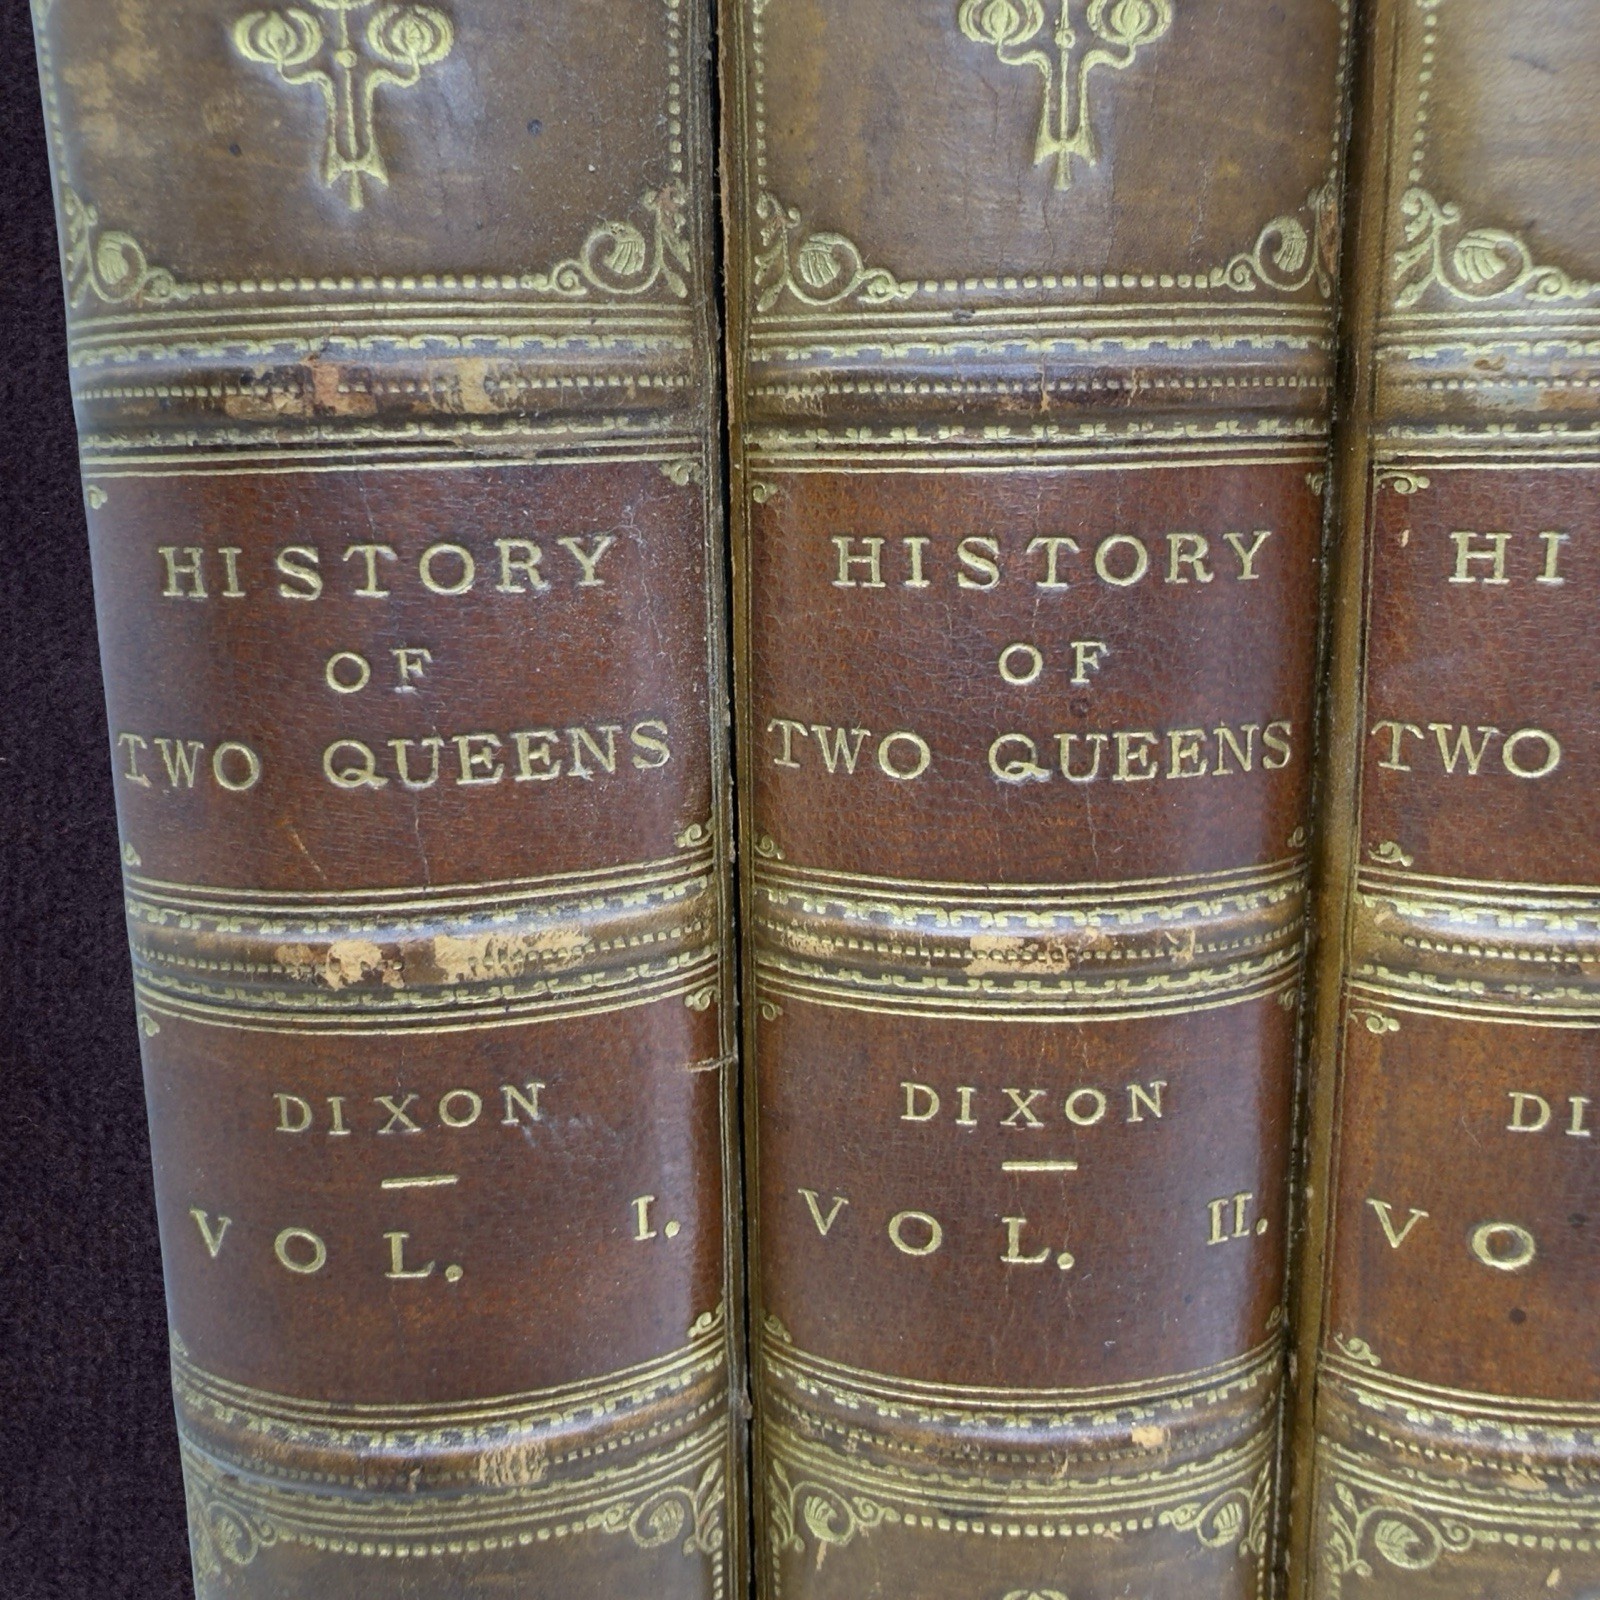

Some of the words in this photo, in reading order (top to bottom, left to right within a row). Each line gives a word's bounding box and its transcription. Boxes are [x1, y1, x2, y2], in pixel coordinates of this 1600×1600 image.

[157, 534, 616, 601] HISTORY
[831, 530, 1271, 592] HISTORY
[325, 647, 433, 693] OF
[998, 641, 1109, 685] OF
[118, 732, 262, 791] TWO
[322, 719, 672, 791] QUEENS
[767, 718, 931, 780] TWO
[988, 719, 1293, 785] QUEENS
[1371, 719, 1562, 779] TWO
[273, 1082, 546, 1136] DIXON
[900, 1080, 1168, 1128] DIXON
[189, 1207, 464, 1283] VOL.
[630, 1194, 682, 1241] I.
[797, 1188, 1076, 1270] VOL.
[1206, 1192, 1269, 1246] II.
